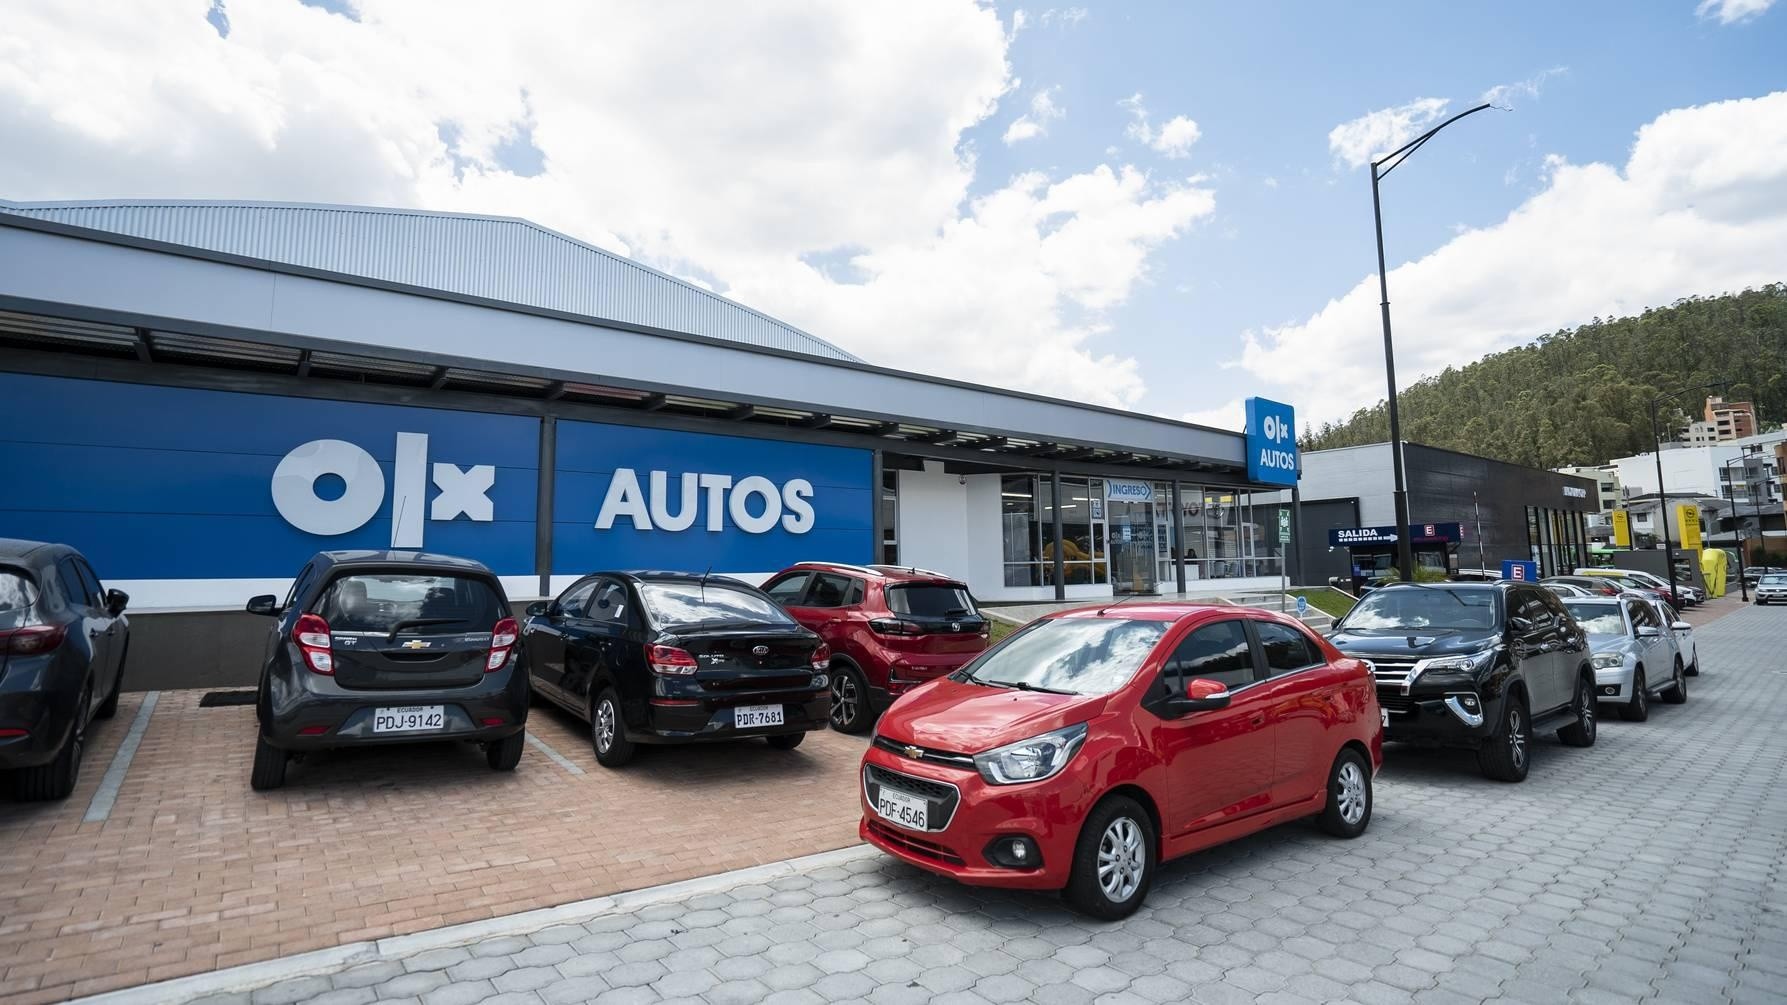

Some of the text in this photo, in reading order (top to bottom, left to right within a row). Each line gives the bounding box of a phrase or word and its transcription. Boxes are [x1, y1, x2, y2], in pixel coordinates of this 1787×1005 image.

[1263, 415, 1288, 444] olx
[1260, 448, 1294, 470] AUTOS
[271, 432, 495, 548] olx
[1112, 484, 1146, 496] INGRESO
[594, 467, 815, 535] AUTOS
[1338, 528, 1378, 538] SALIDA
[1426, 526, 1433, 535] E
[1513, 566, 1522, 578] E
[376, 713, 442, 730] PDJ-9142
[736, 711, 783, 726] PDR-7681
[893, 792, 911, 803] ECUADOR
[879, 798, 925, 828] PDF-4546
